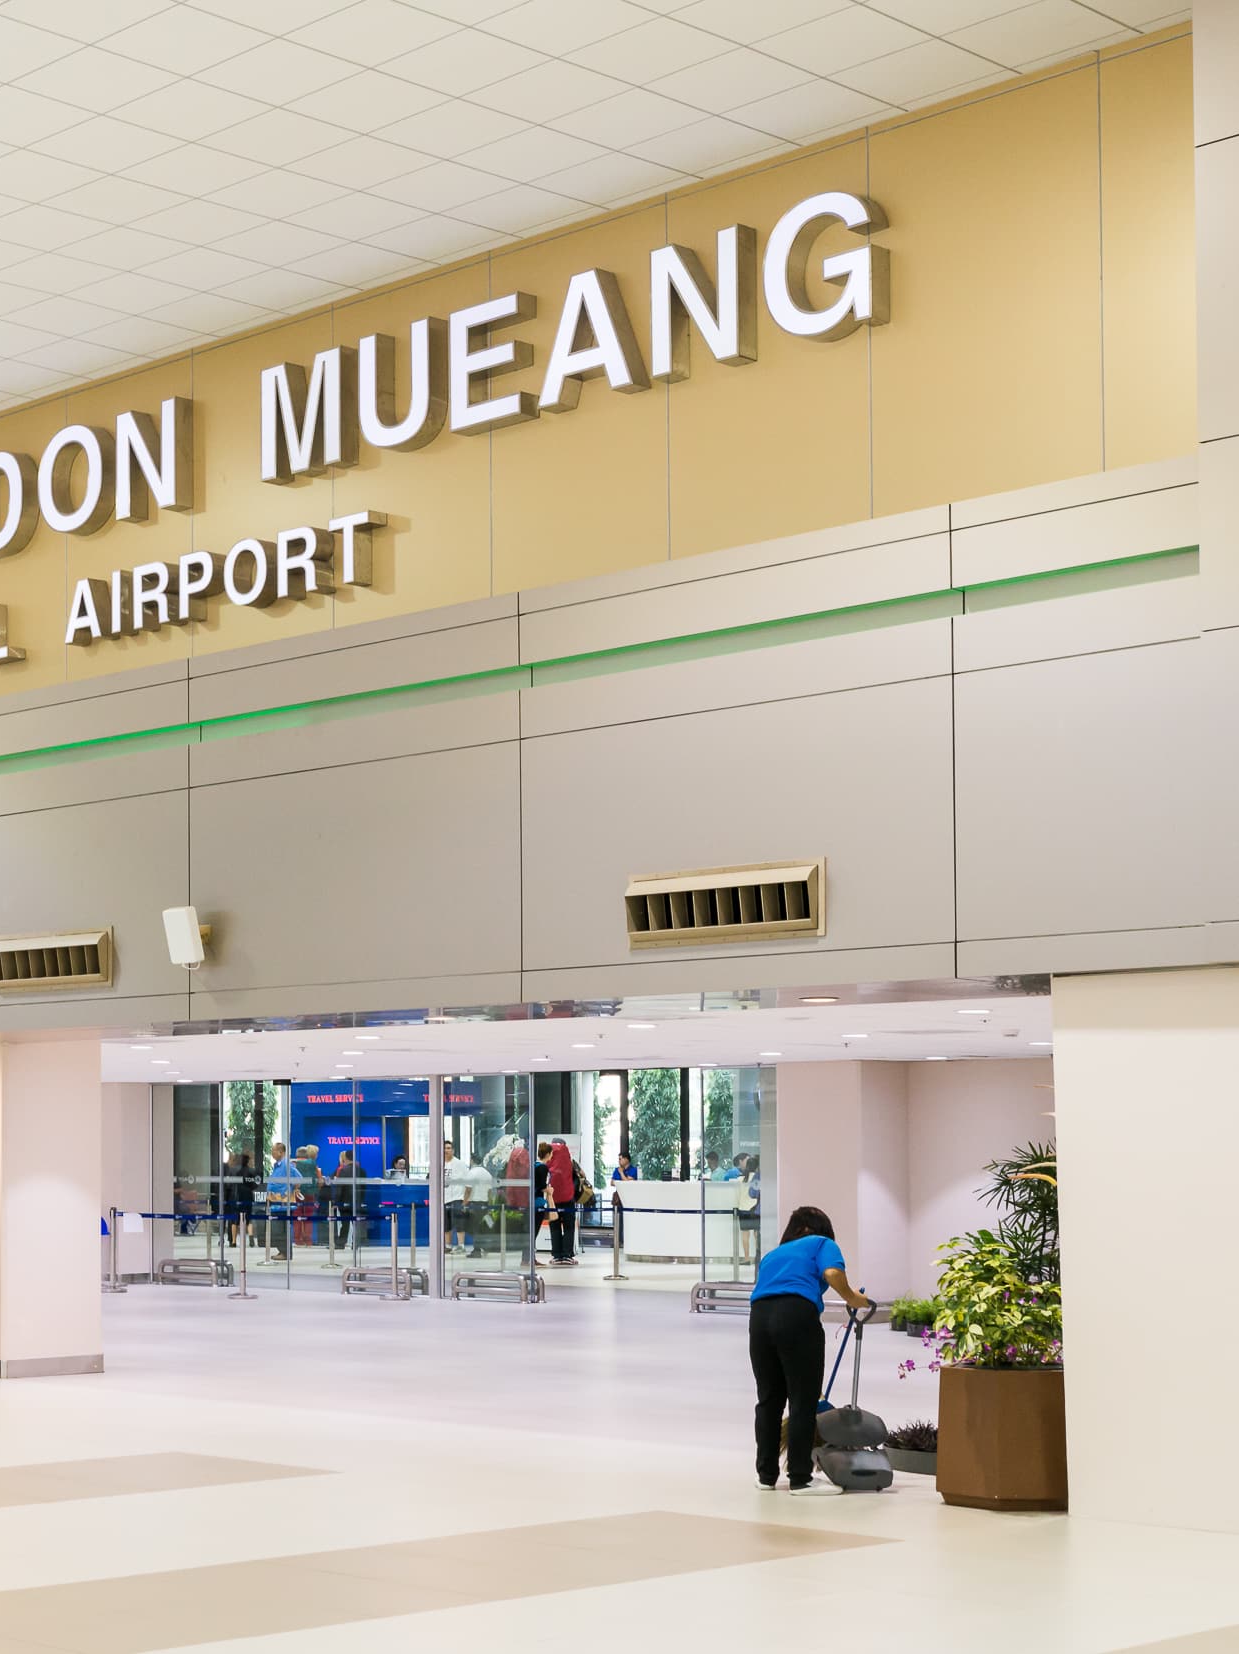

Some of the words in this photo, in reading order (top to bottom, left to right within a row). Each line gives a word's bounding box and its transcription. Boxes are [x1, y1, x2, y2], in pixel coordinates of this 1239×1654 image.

[261, 190, 875, 485] MUEANG
[65, 510, 373, 646] AIRPORT
[307, 1095, 334, 1104] TRAVEL
[335, 1094, 364, 1103] SERVE
[327, 1136, 353, 1145] TRAVEL
[254, 1191, 267, 1203] TRAV
